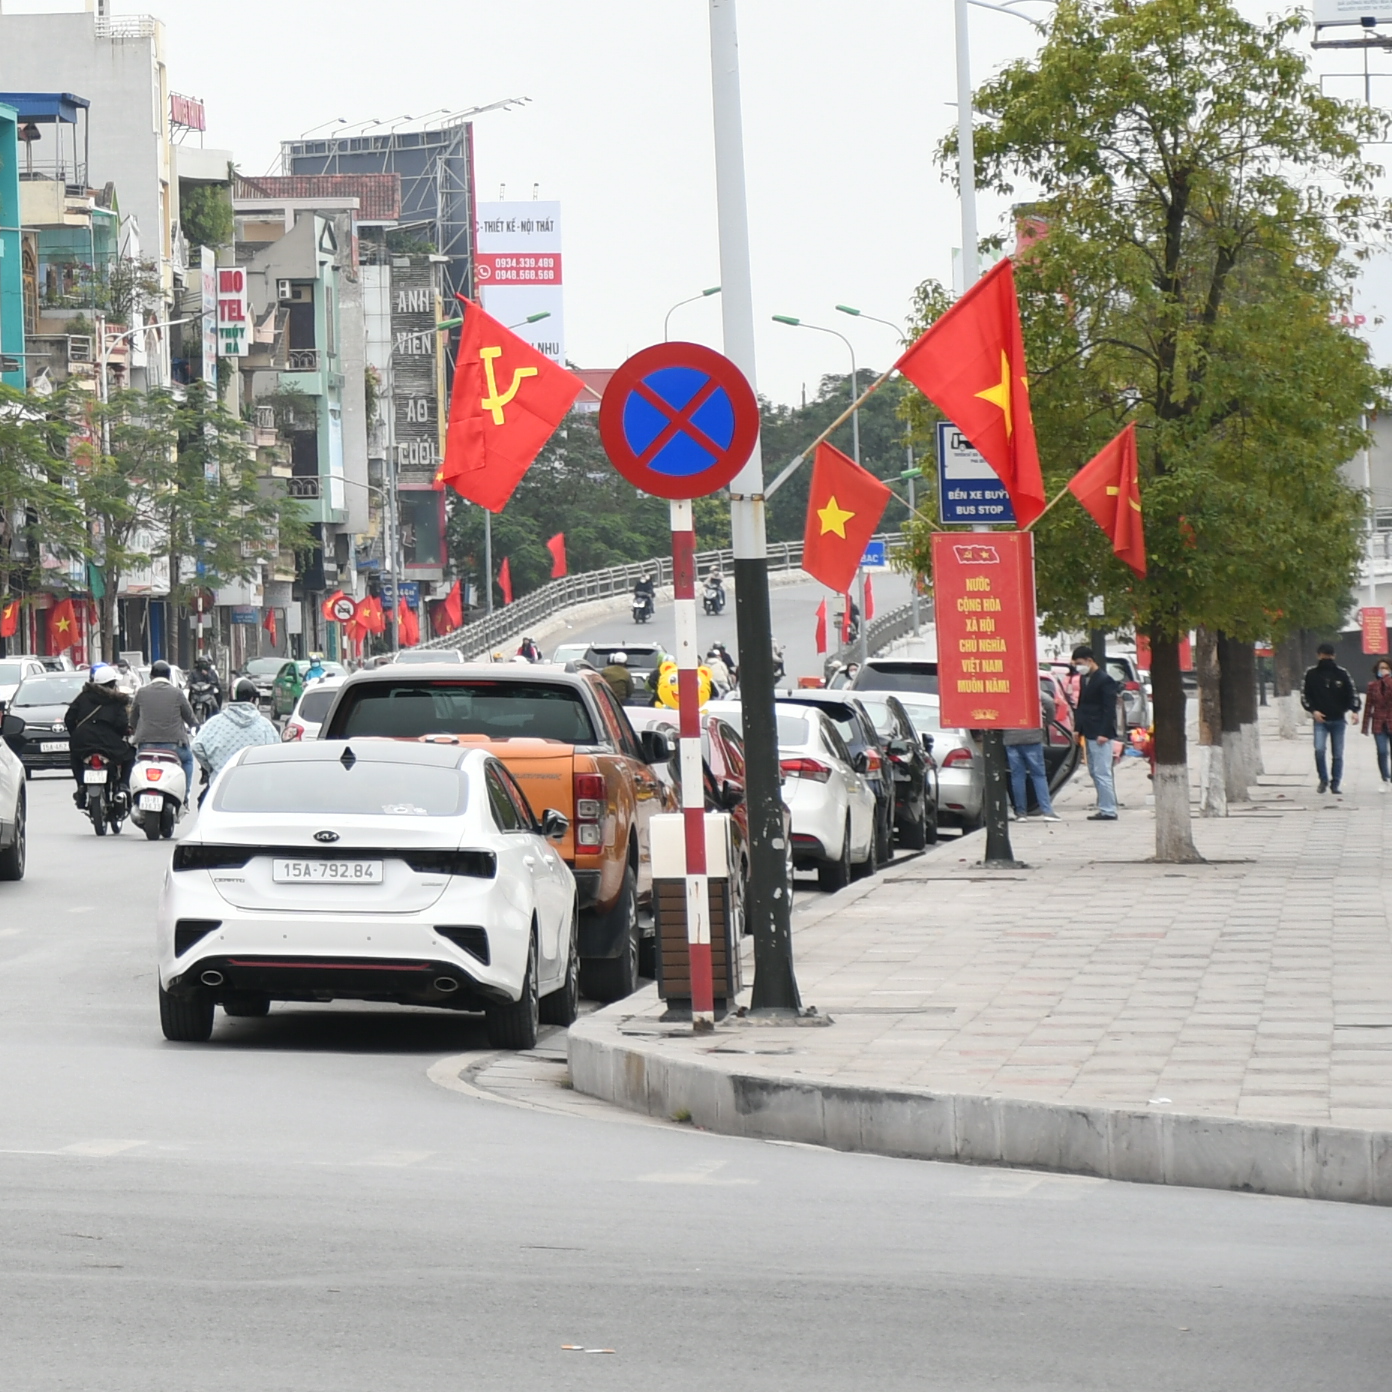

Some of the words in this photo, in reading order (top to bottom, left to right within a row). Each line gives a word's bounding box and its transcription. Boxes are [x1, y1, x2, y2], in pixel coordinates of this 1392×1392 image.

[484, 217, 504, 233] THIẾT
[506, 217, 516, 233] KẾ
[520, 218, 534, 235] NỘI
[536, 216, 554, 233] THẤT
[219, 270, 244, 293] MO
[218, 299, 245, 322] TEL
[948, 487, 967, 500] BẾN
[969, 491, 983, 499] XE
[956, 506, 976, 515] BUS
[978, 505, 1004, 515] STOP
[965, 575, 991, 591] NƯỚC
[957, 598, 982, 614] CỘNG
[983, 595, 1001, 612] HÒA
[965, 616, 978, 632] XÃ
[979, 617, 995, 635] HỘI
[959, 636, 977, 652] CHỦ
[979, 637, 1007, 652] NGHĨA
[961, 658, 980, 675] VIỆT
[982, 659, 1003, 673] NAM
[957, 678, 984, 693] MUÔN
[986, 678, 1010, 693] NĂM!
[284, 862, 374, 879] 15A-792.84
